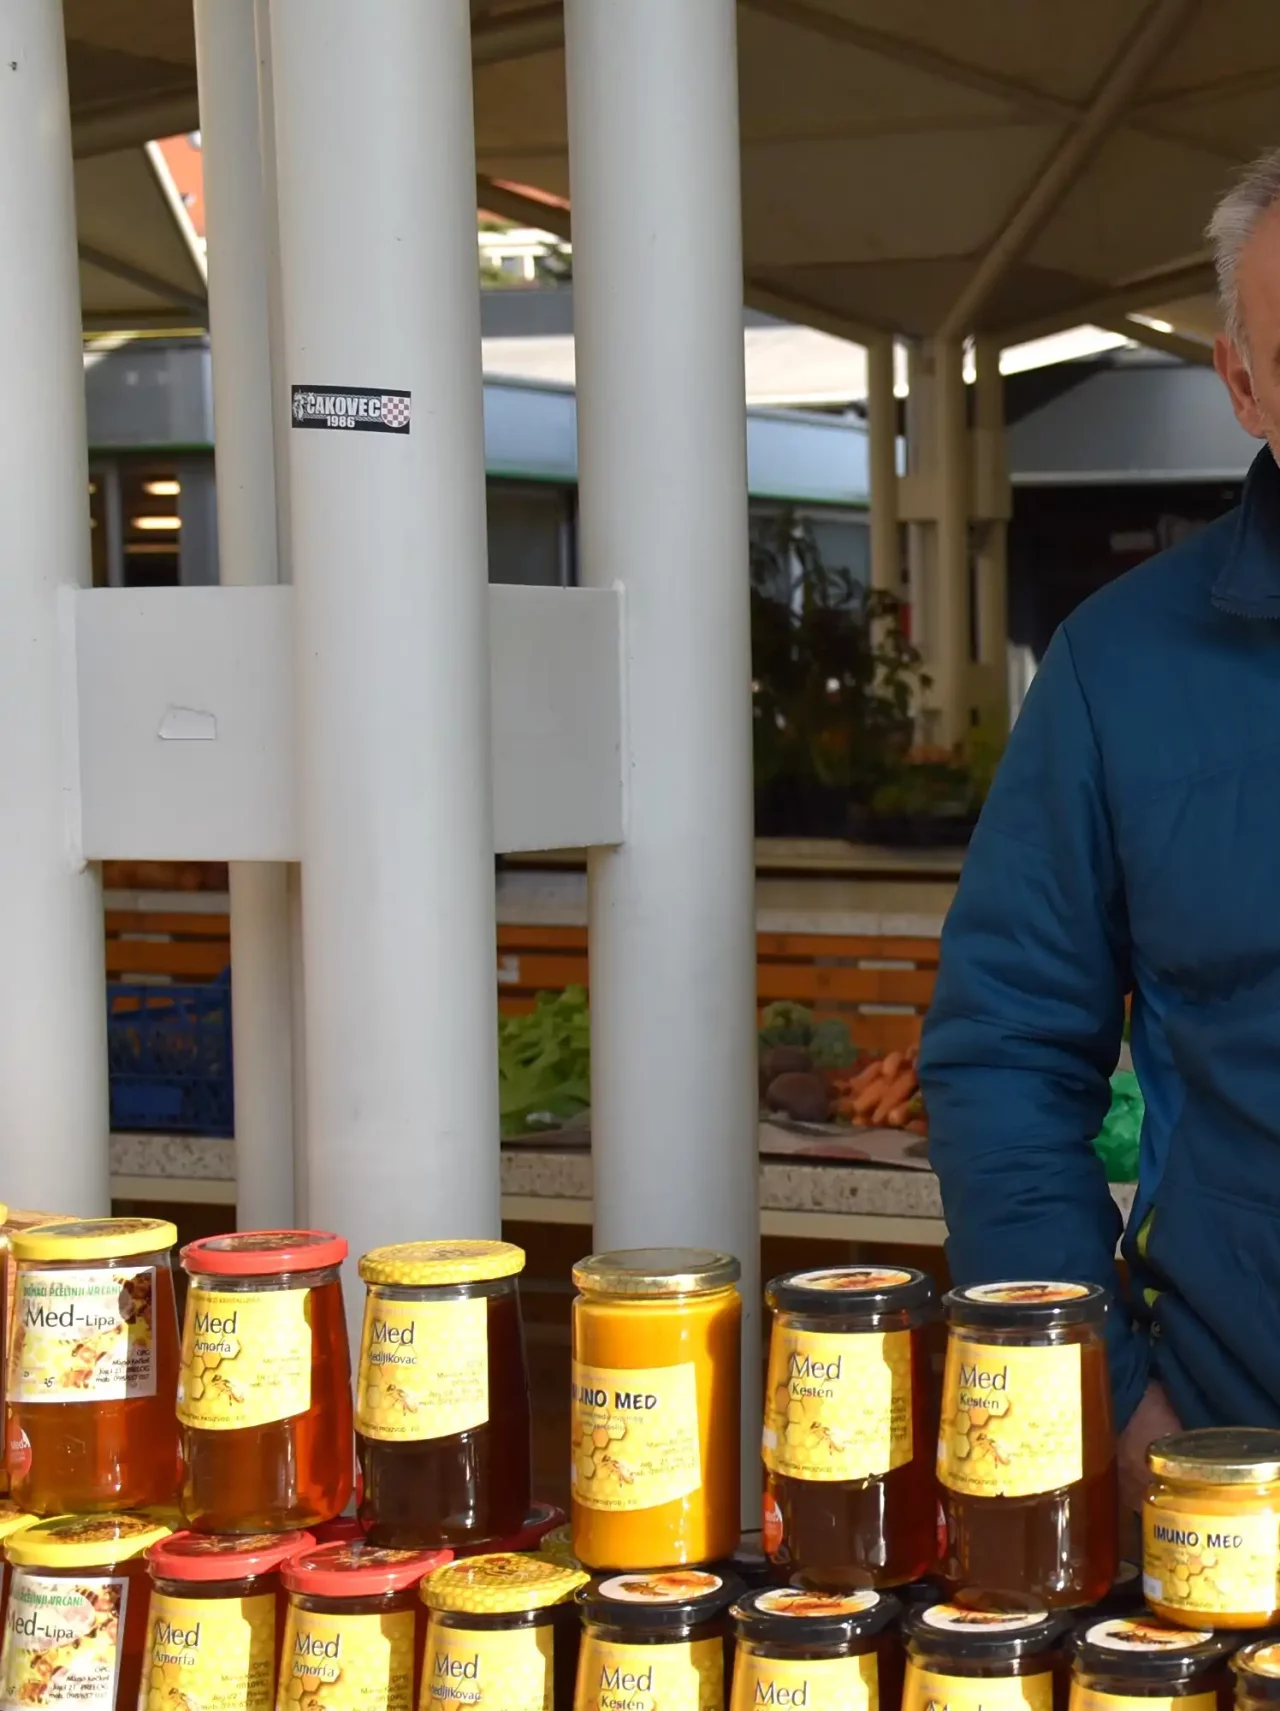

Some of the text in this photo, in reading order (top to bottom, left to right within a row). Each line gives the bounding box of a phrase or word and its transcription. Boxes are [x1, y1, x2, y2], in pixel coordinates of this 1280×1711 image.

[306, 392, 381, 417] ČAKOVEC
[326, 415, 355, 428] 1986
[194, 1310, 237, 1334] Med
[372, 1320, 415, 1345] Med
[194, 1339, 231, 1353] Amorfa
[790, 1354, 842, 1380] Med
[960, 1363, 1008, 1390] Med
[615, 1391, 657, 1410] MED
[791, 1382, 833, 1398] Kesten
[959, 1392, 1000, 1409] Kesten
[1153, 1524, 1243, 1549] IMUNO MED
[156, 1622, 200, 1647] Med
[295, 1631, 340, 1658] Med
[154, 1650, 195, 1666] Amorfa
[293, 1660, 334, 1677] Amorfa
[434, 1651, 479, 1679] Med
[600, 1664, 652, 1692] Med
[601, 1695, 645, 1711] Kesten
[754, 1678, 807, 1707] Med
